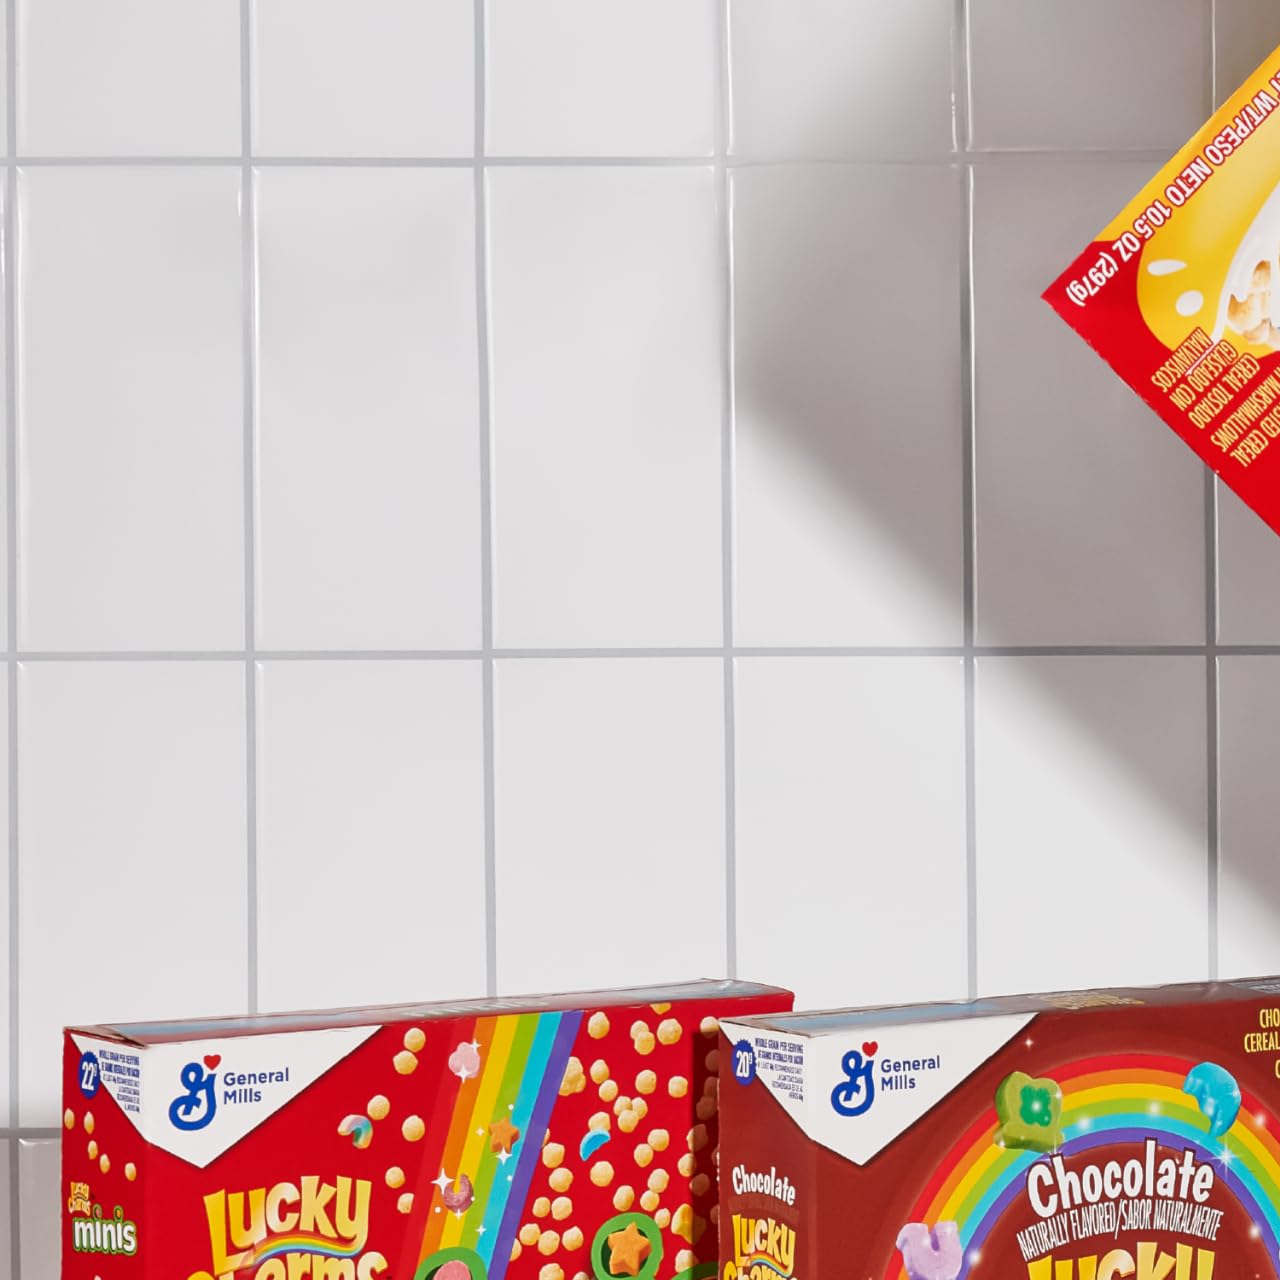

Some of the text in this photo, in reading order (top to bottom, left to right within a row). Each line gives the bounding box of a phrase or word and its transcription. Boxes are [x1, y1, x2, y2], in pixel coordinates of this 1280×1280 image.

[1199, 88, 1279, 166] WT/PESO
[1161, 155, 1214, 207] NETO
[1131, 197, 1174, 240] 10.5
[1110, 230, 1142, 261] OZ
[1066, 250, 1119, 307] (297g)
[1148, 327, 1213, 392] MALVAVISCOS
[1167, 338, 1239, 411] GLASEADO CON
[1186, 352, 1261, 429] CEREAL TOSTADO
[1229, 427, 1270, 469] CEREAL
[881, 1055, 940, 1073] General
[1244, 1033, 1280, 1052] CEREAL
[224, 1068, 289, 1087] General
[224, 1089, 262, 1104] Mills
[881, 1075, 916, 1090] Mills
[69, 1182, 90, 1201] Lucky
[732, 1164, 795, 1206] Chocolate
[1026, 1138, 1214, 1218] Chocolate
[68, 1197, 91, 1214] Charms
[203, 1175, 372, 1276] Lucky
[73, 1207, 136, 1253] minis
[732, 1213, 795, 1277] Lucky
[1017, 1214, 1069, 1261] NATURALLY
[1154, 1204, 1224, 1240] NATURALMENTE
